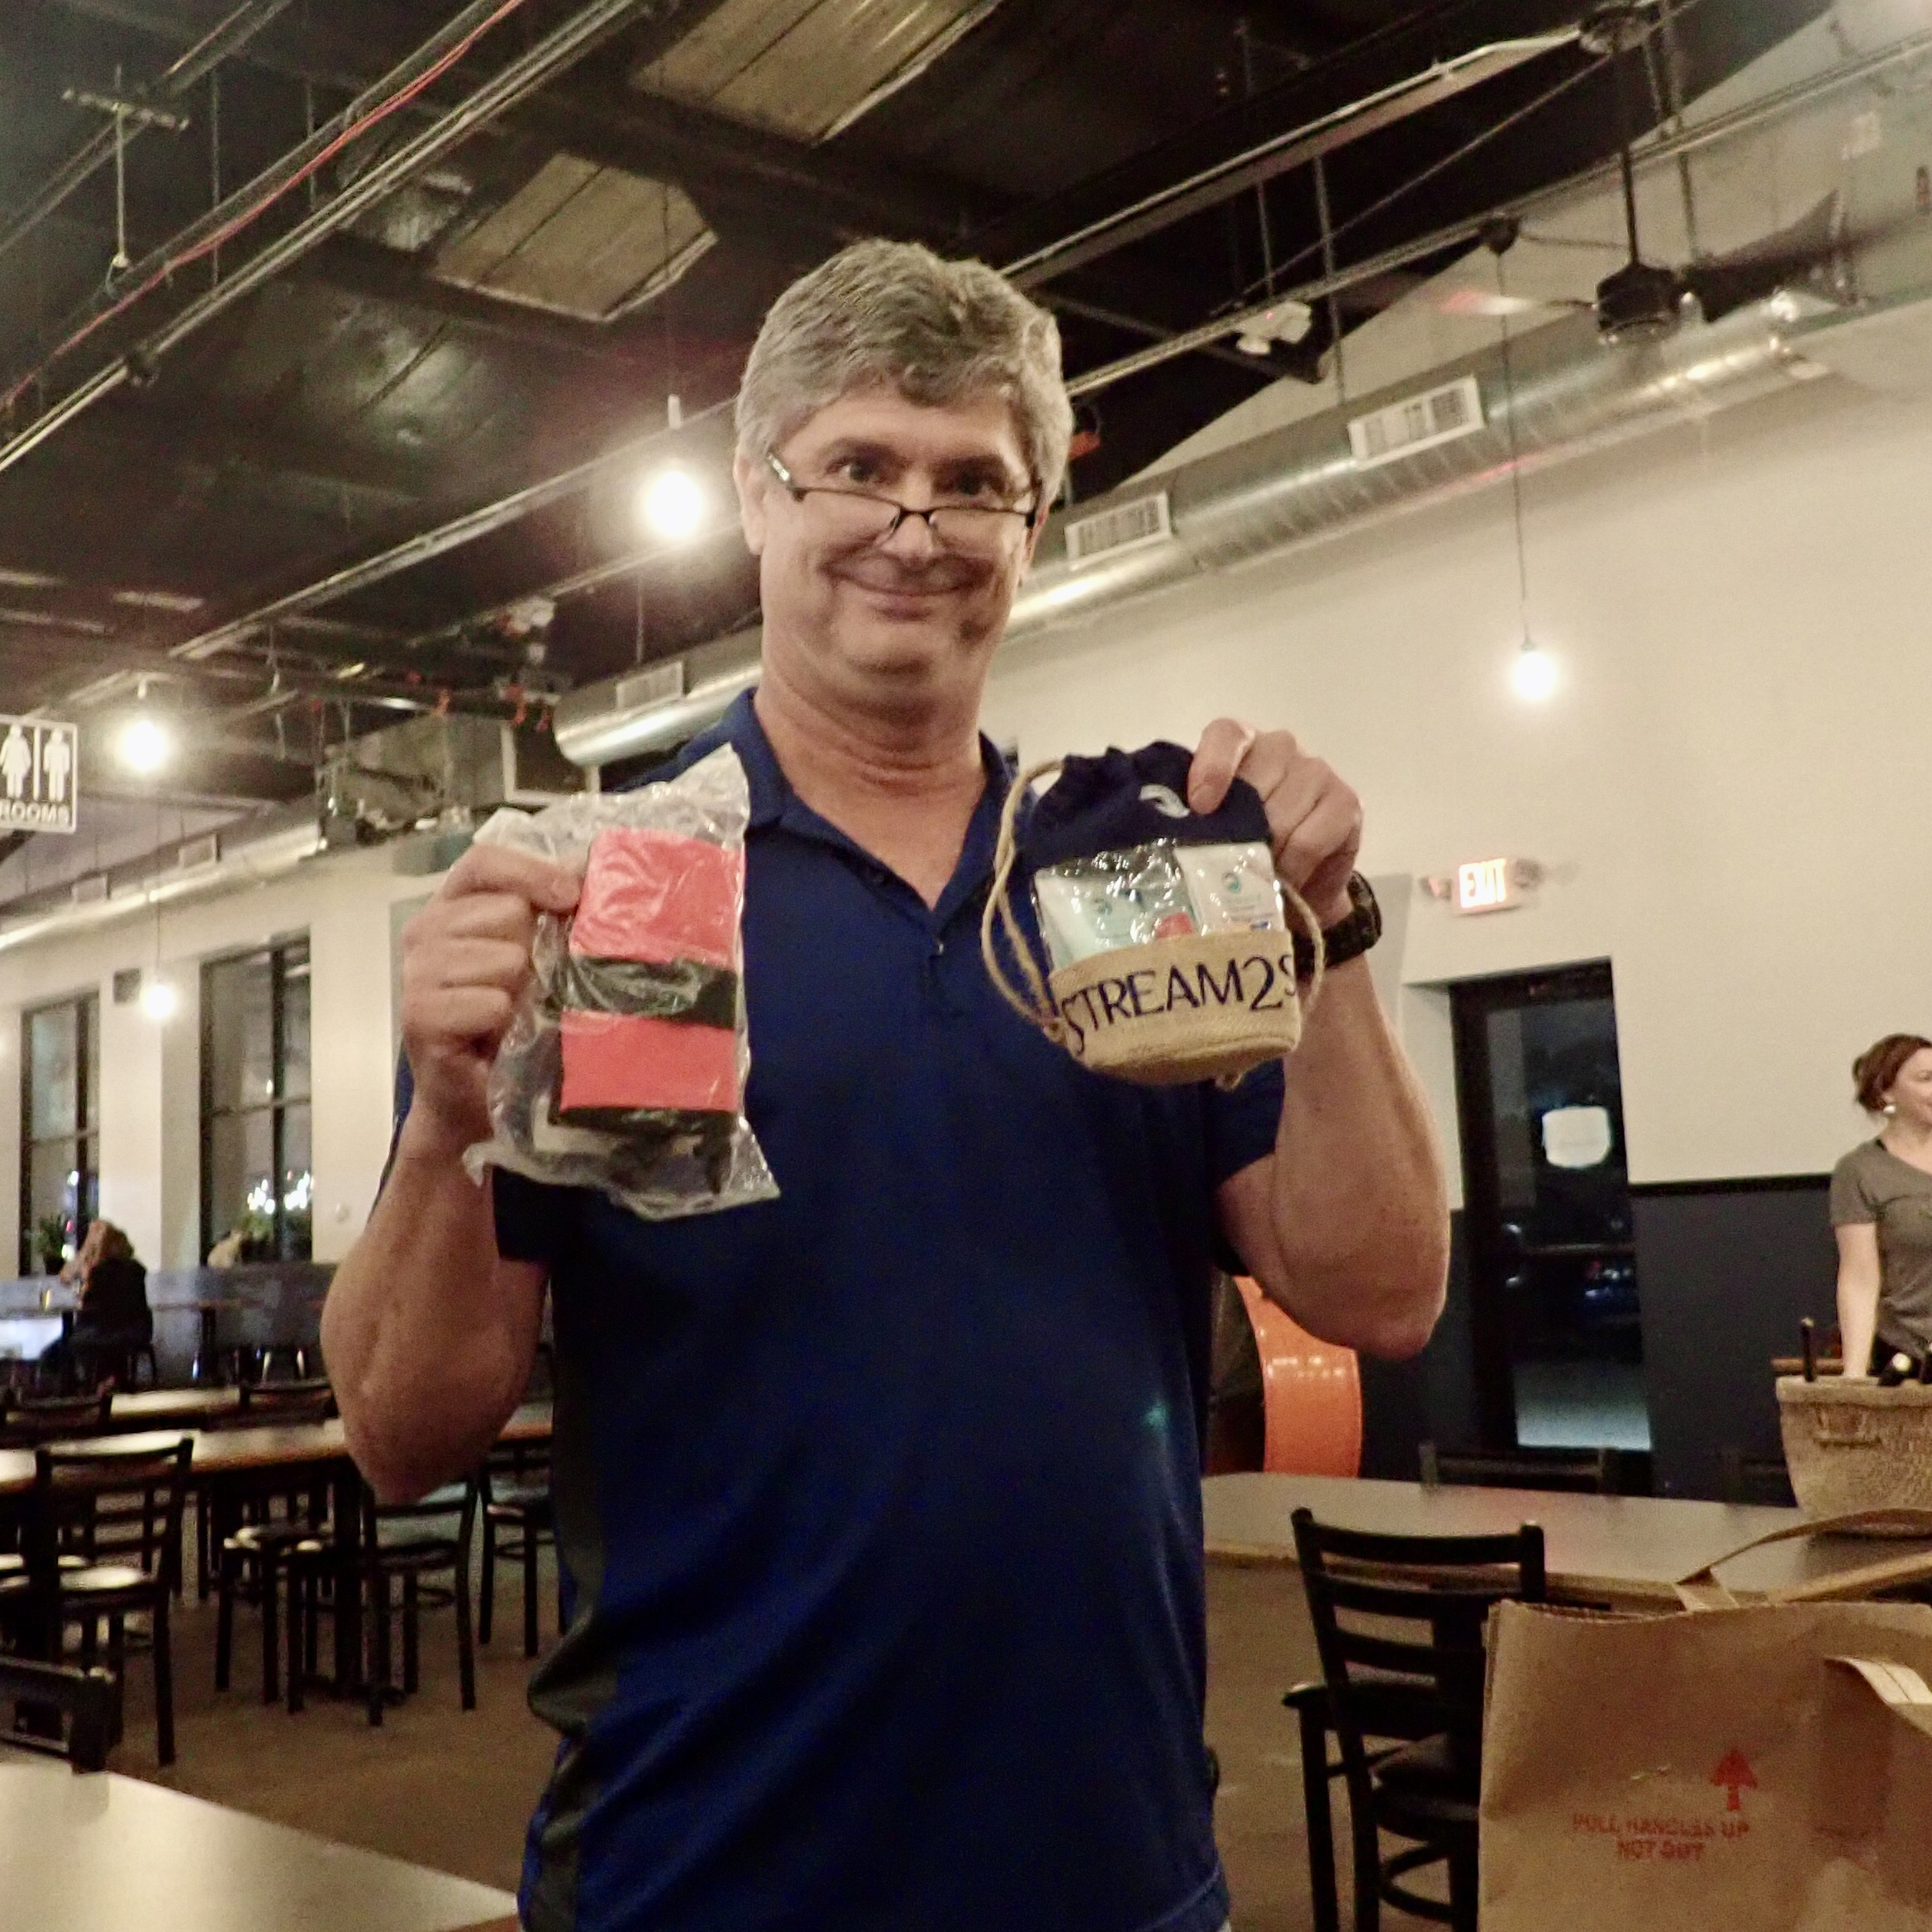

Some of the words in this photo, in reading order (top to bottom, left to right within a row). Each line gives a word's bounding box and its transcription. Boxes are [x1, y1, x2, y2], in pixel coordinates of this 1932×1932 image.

[1459, 859, 1506, 907] EXIT
[1720, 1820, 1750, 1839] UP
[1616, 1839, 1655, 1858] NOT
